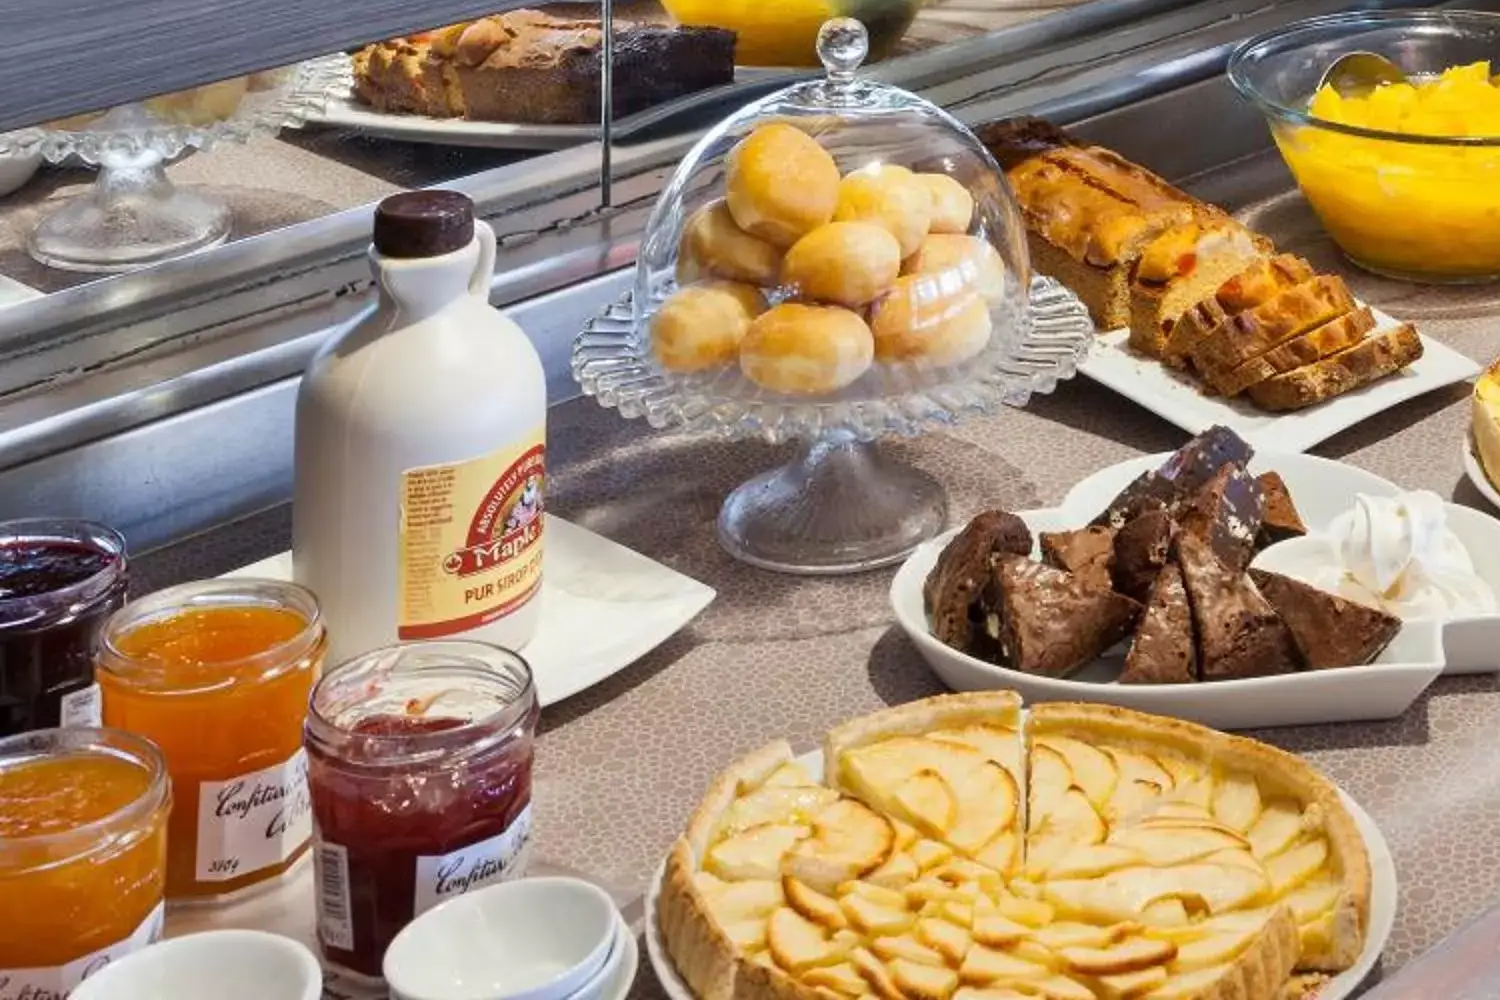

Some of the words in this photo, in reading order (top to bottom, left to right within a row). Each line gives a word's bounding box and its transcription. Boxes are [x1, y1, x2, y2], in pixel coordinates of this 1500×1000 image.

[477, 471, 518, 534] ABSOLUTELY
[473, 523, 539, 568] Maple
[465, 583, 494, 604] PUR
[497, 566, 528, 592] SIROP
